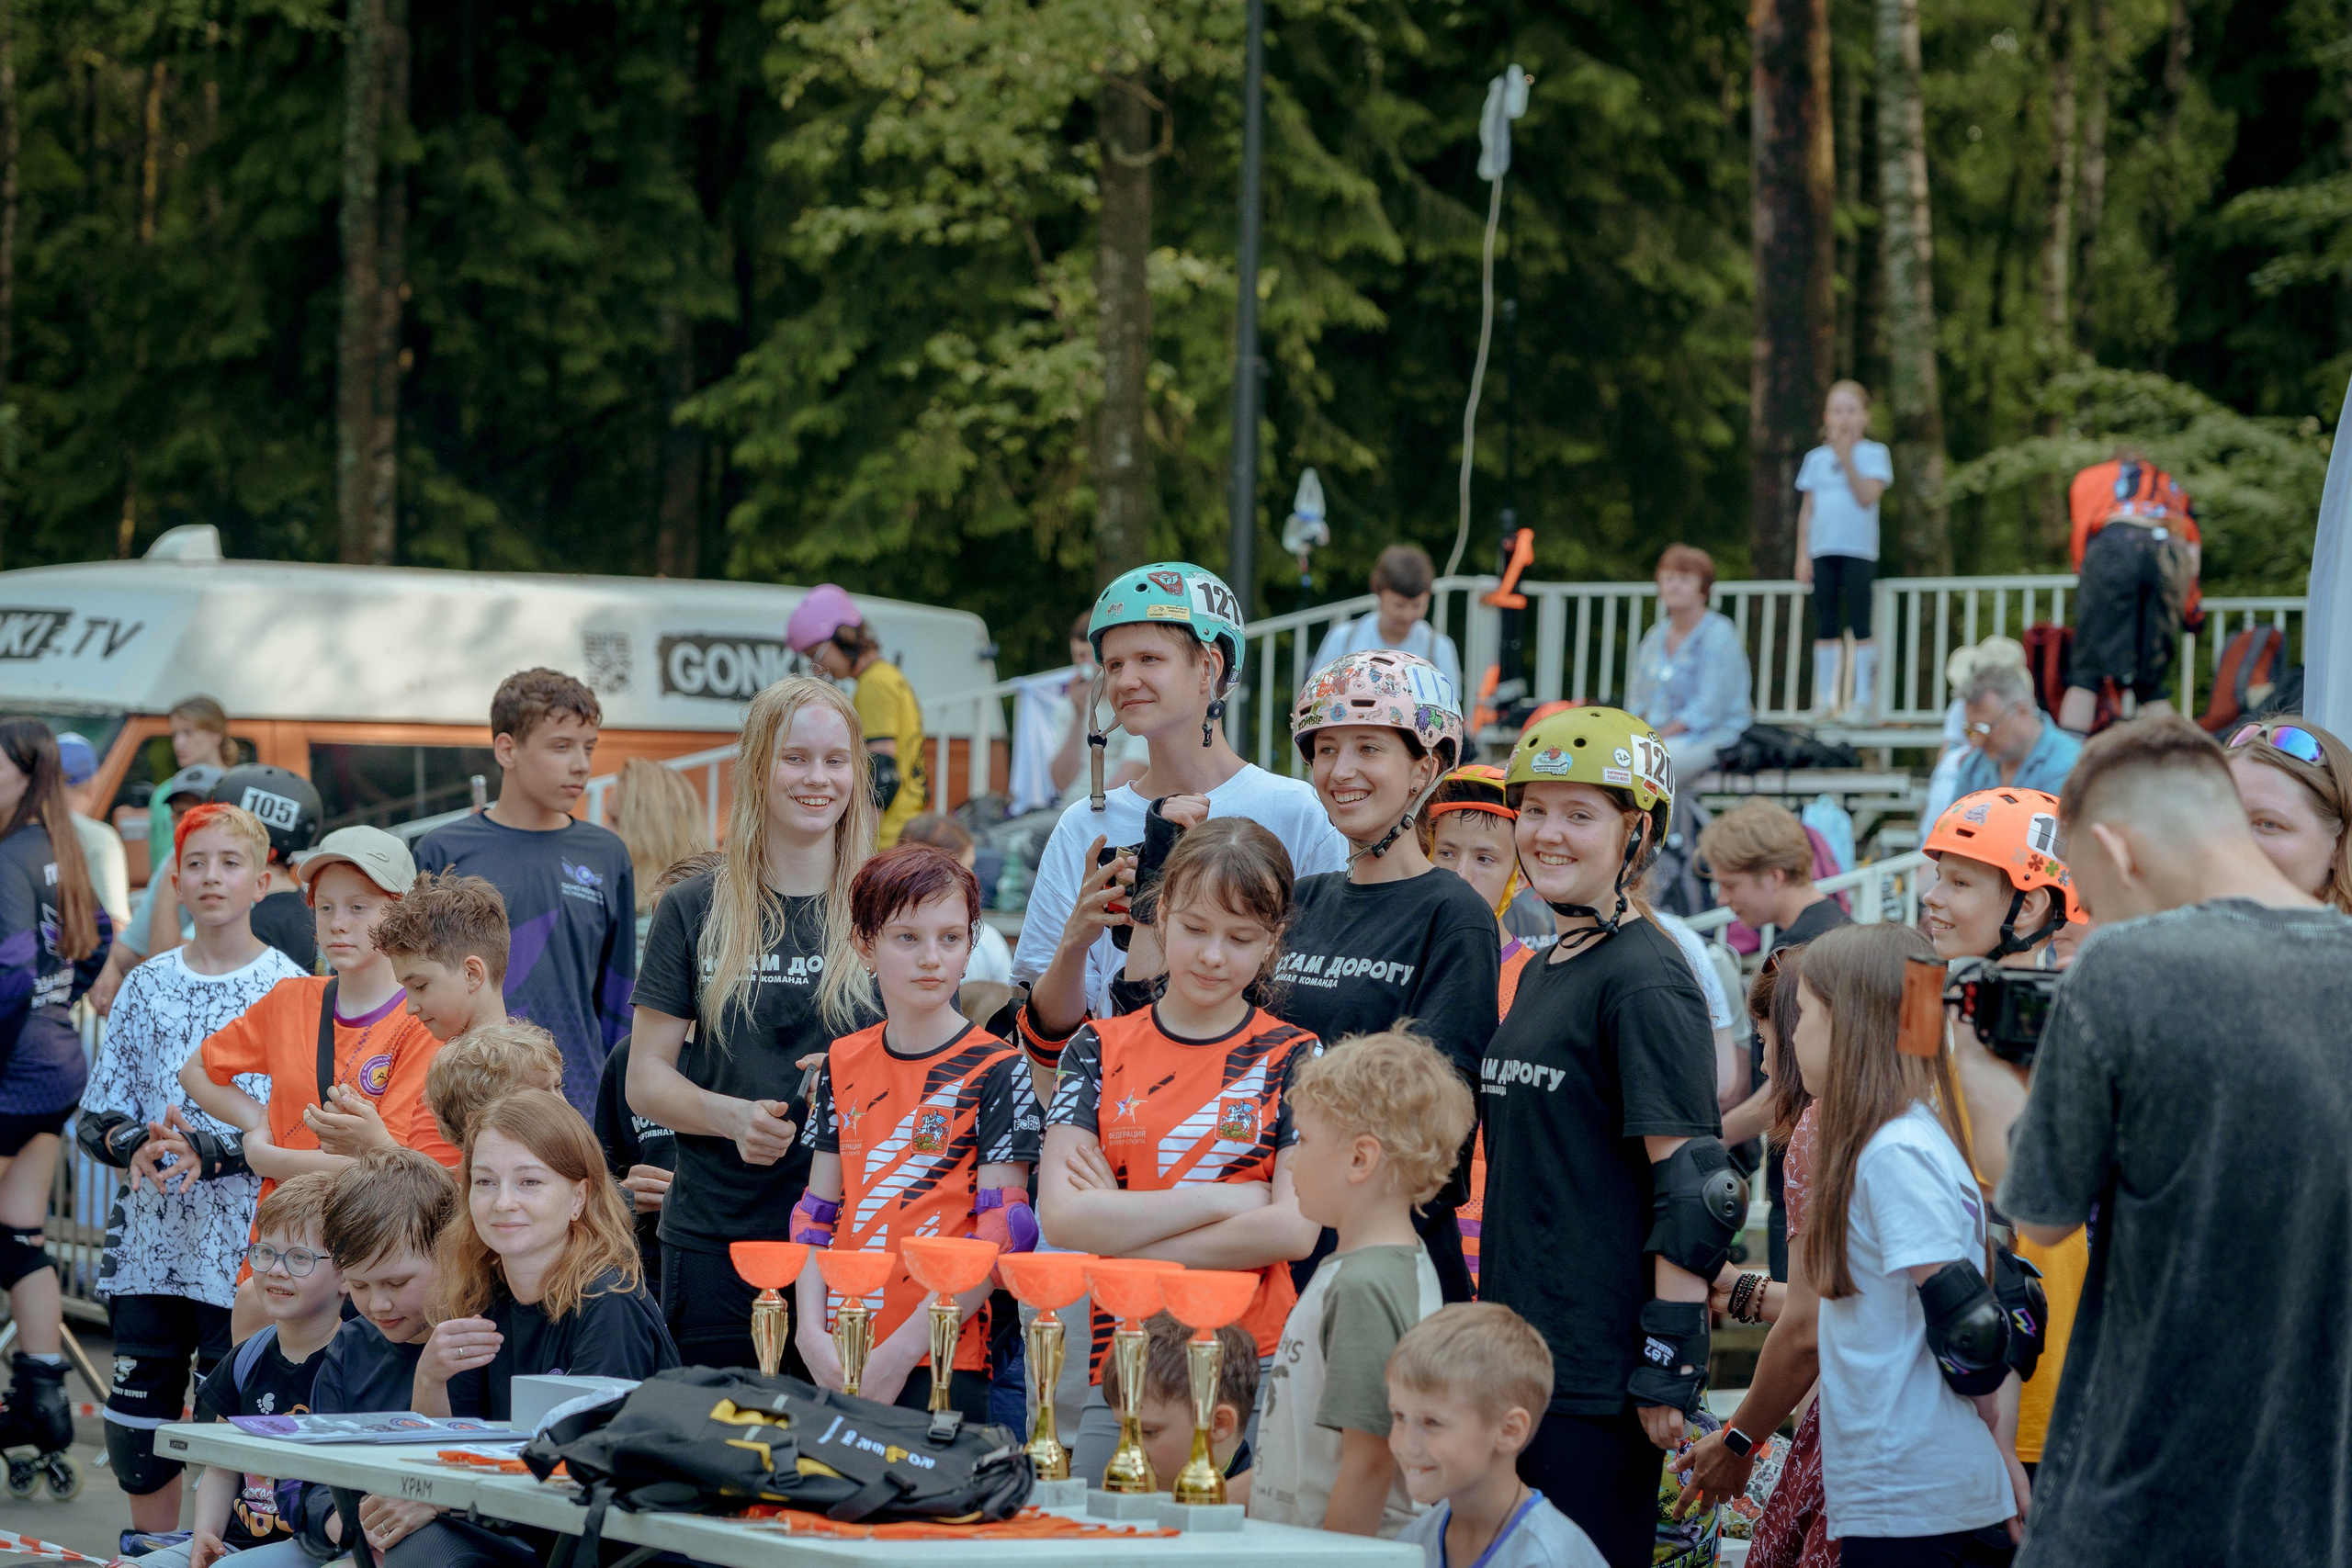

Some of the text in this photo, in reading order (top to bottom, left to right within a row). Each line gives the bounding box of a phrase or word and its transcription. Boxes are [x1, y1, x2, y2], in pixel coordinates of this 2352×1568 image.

[1197, 582, 1240, 626] 121
[1638, 741, 1674, 795] 120
[250, 794, 290, 823] 105
[761, 975, 809, 986] КОМАНДА
[1298, 975, 1338, 988] КОМАНДА
[1324, 956, 1415, 987] ДОРОГУ
[1108, 1130, 1147, 1140] ФЕДЕРАЦИЯ
[1644, 1345, 1671, 1367] 187
